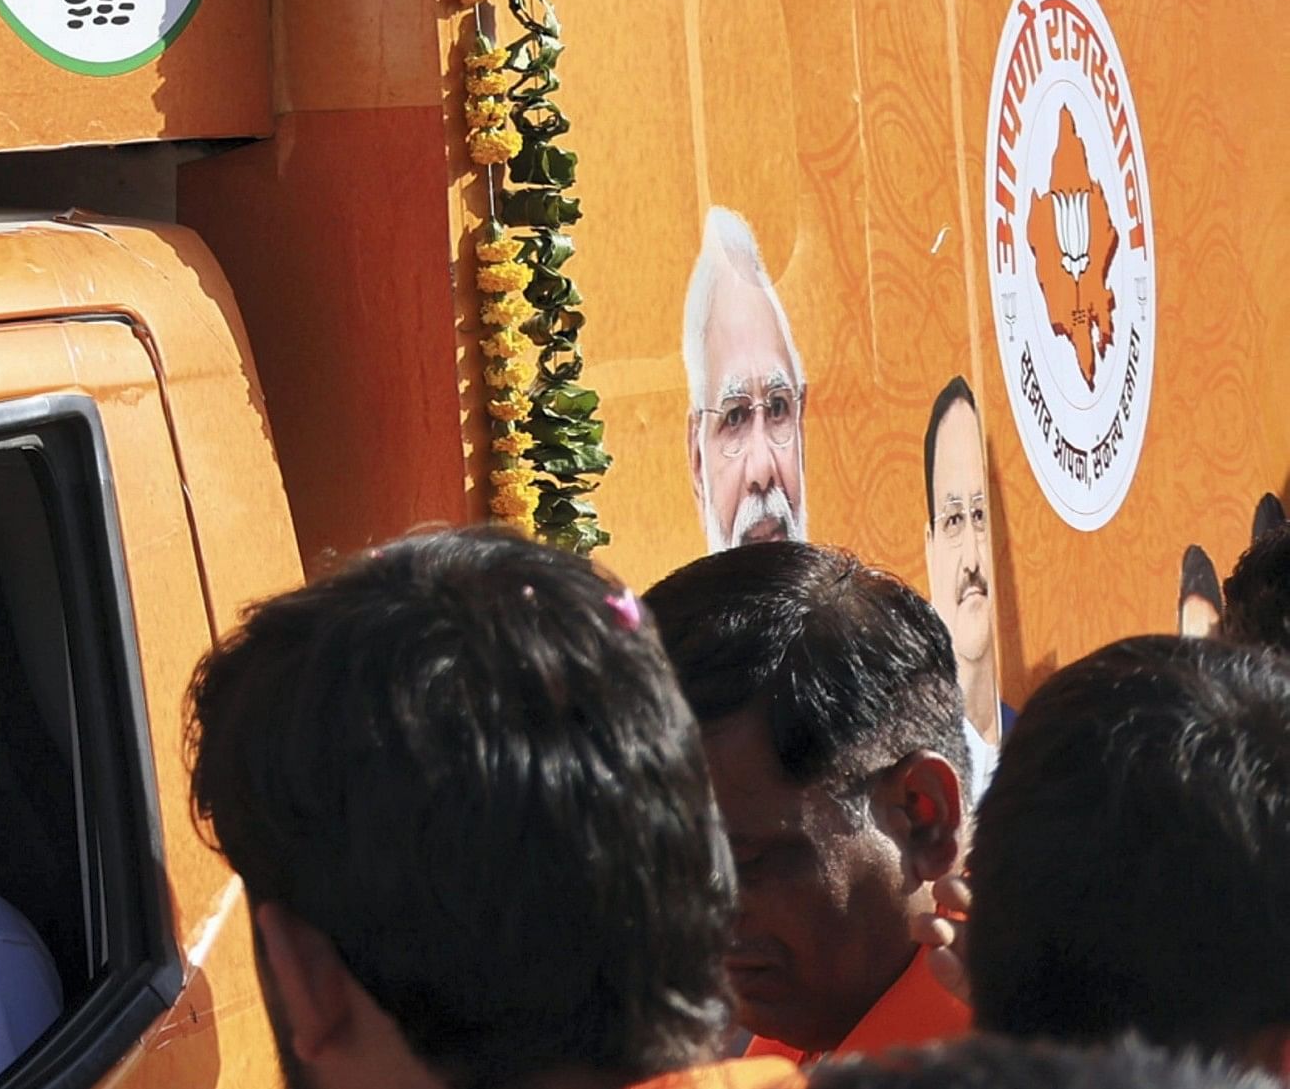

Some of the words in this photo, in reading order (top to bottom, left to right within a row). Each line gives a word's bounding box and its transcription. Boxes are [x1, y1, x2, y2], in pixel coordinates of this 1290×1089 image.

[996, 0, 1042, 274] आपणो
[1021, 340, 1053, 443] सुझाव
[1091, 410, 1124, 480] संकल्प
[1119, 322, 1141, 422] हमारा
